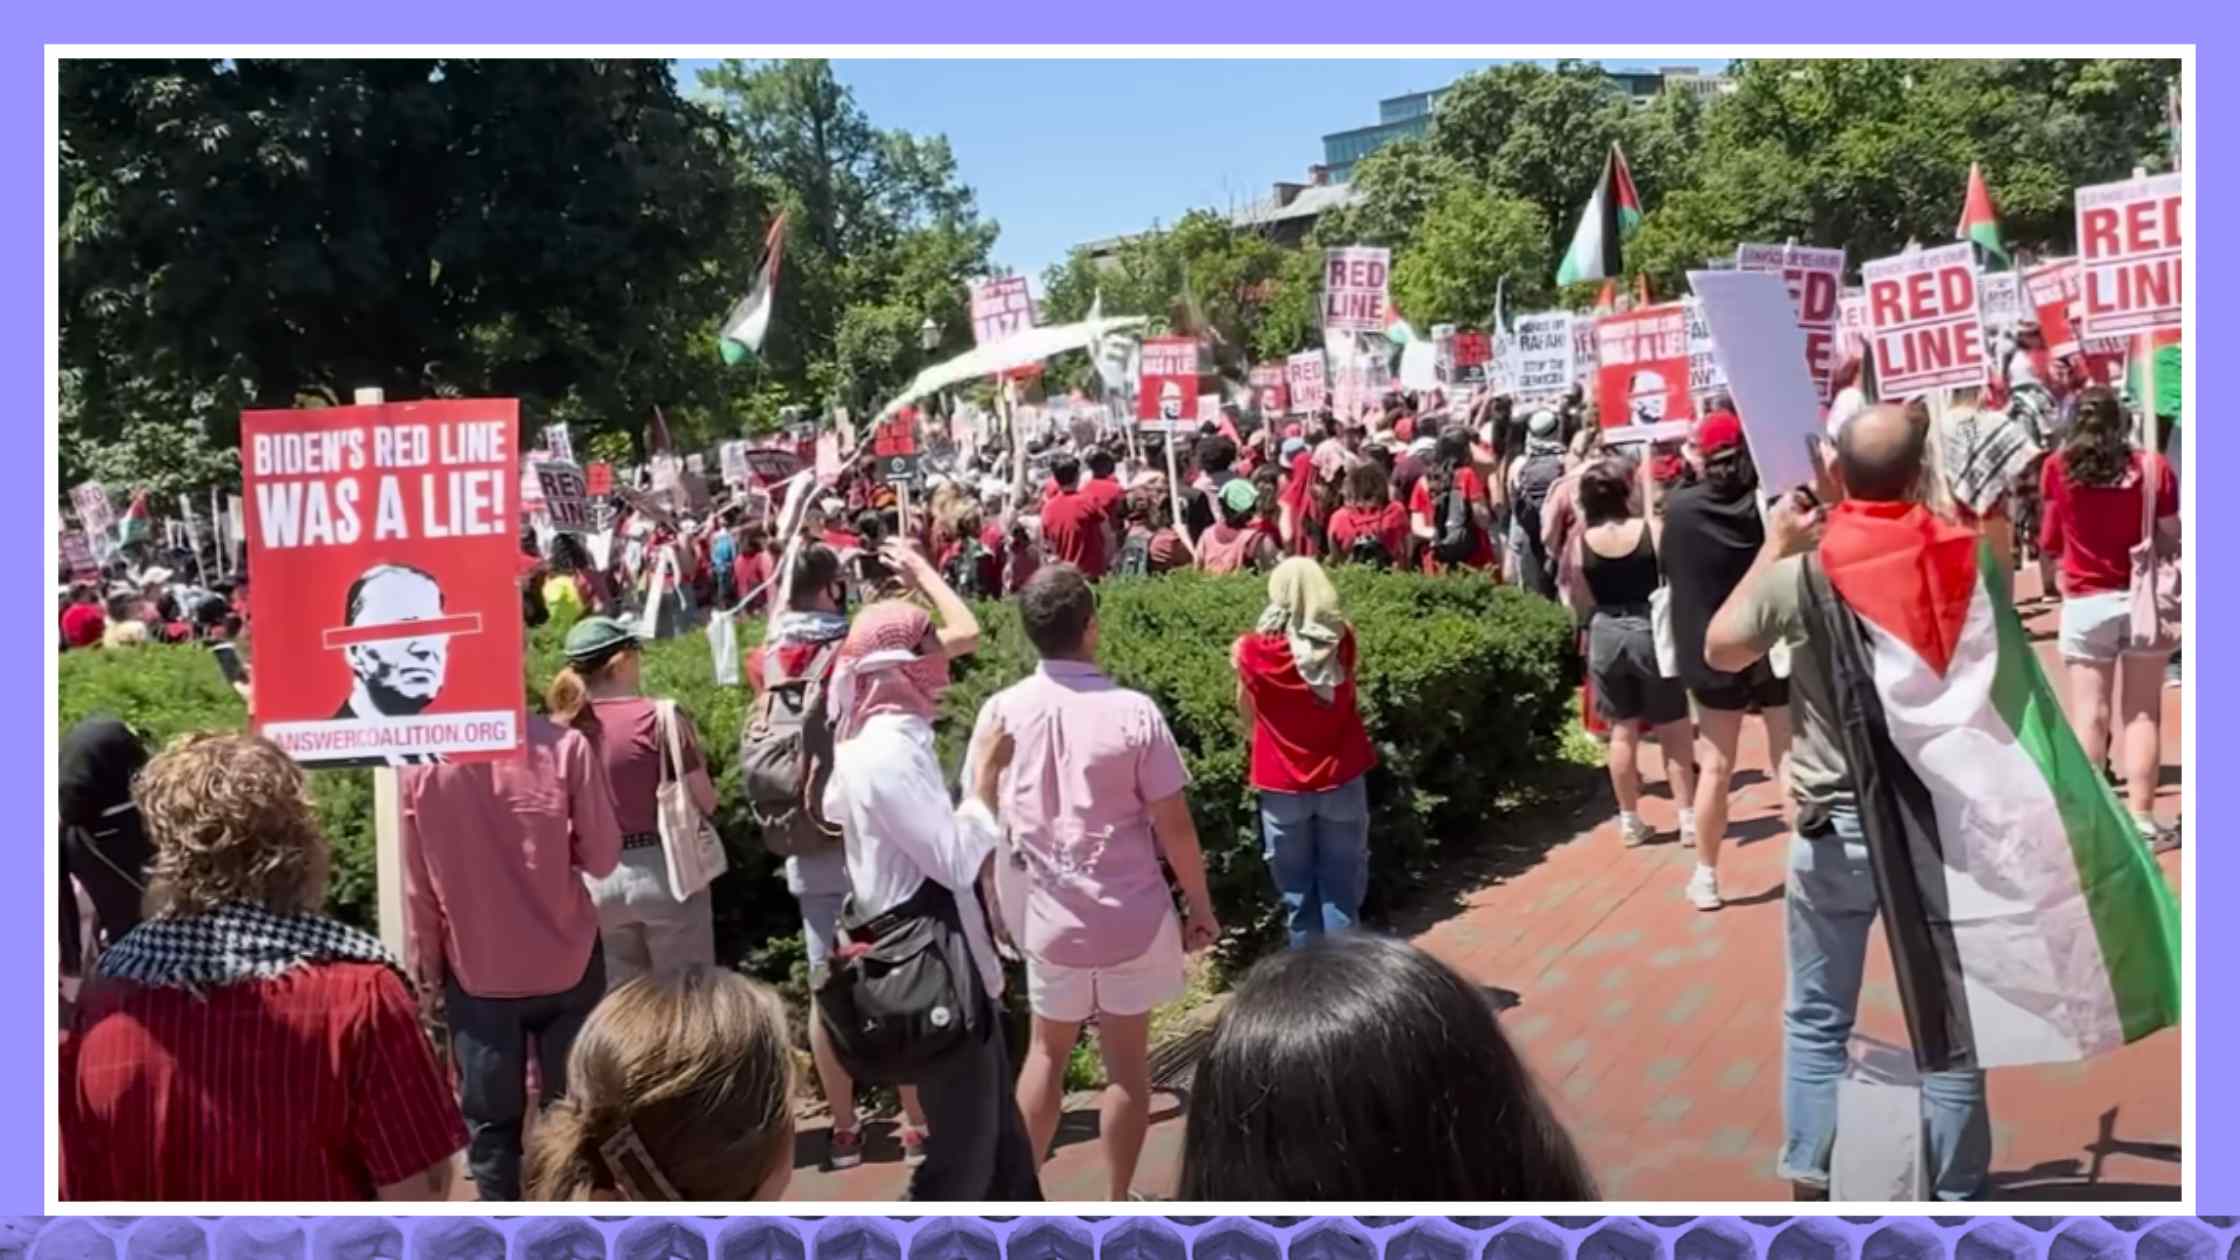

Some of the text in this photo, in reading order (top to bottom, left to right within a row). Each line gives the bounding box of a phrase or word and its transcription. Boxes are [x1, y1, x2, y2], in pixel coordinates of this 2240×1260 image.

[1330, 260, 1385, 288] RED
[2085, 257, 2182, 315] LIN
[1327, 293, 1382, 319] LINE
[1871, 266, 1975, 326] RED
[1877, 321, 1982, 378] LINE
[1291, 361, 1322, 382] RED
[1293, 383, 1324, 404] LINE
[253, 426, 367, 476] BIDEN'S
[373, 424, 431, 468] RED
[439, 421, 507, 465] LINE
[255, 477, 361, 549] WAS
[373, 475, 409, 541] A
[422, 469, 506, 538] LIE!
[274, 720, 508, 752] ANSWERCOALITION.ORG
